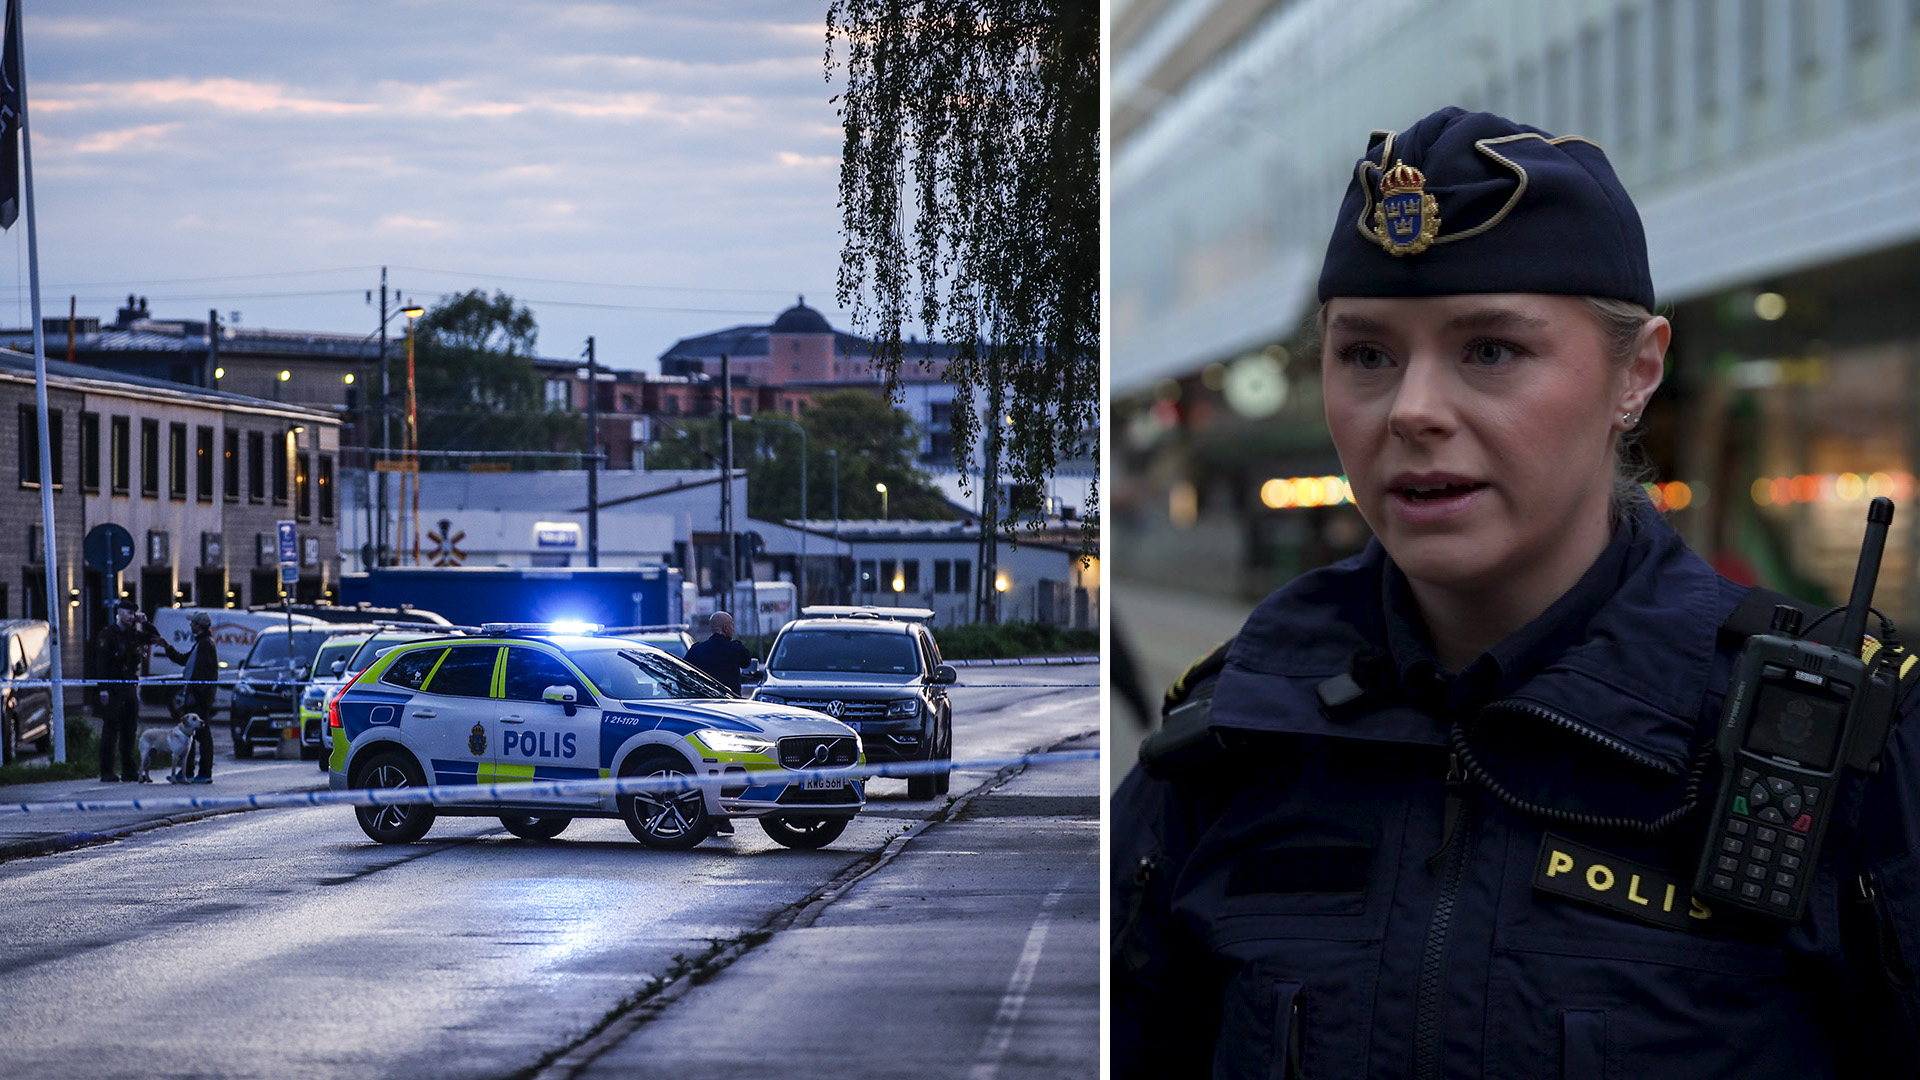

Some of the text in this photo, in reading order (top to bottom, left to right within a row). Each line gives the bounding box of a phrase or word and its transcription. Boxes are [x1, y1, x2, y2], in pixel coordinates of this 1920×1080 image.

[610, 715, 640, 726] 21-1170
[503, 730, 577, 758] POLIS
[807, 778, 842, 789] RWG 56H
[1545, 849, 1713, 920] POLIS
